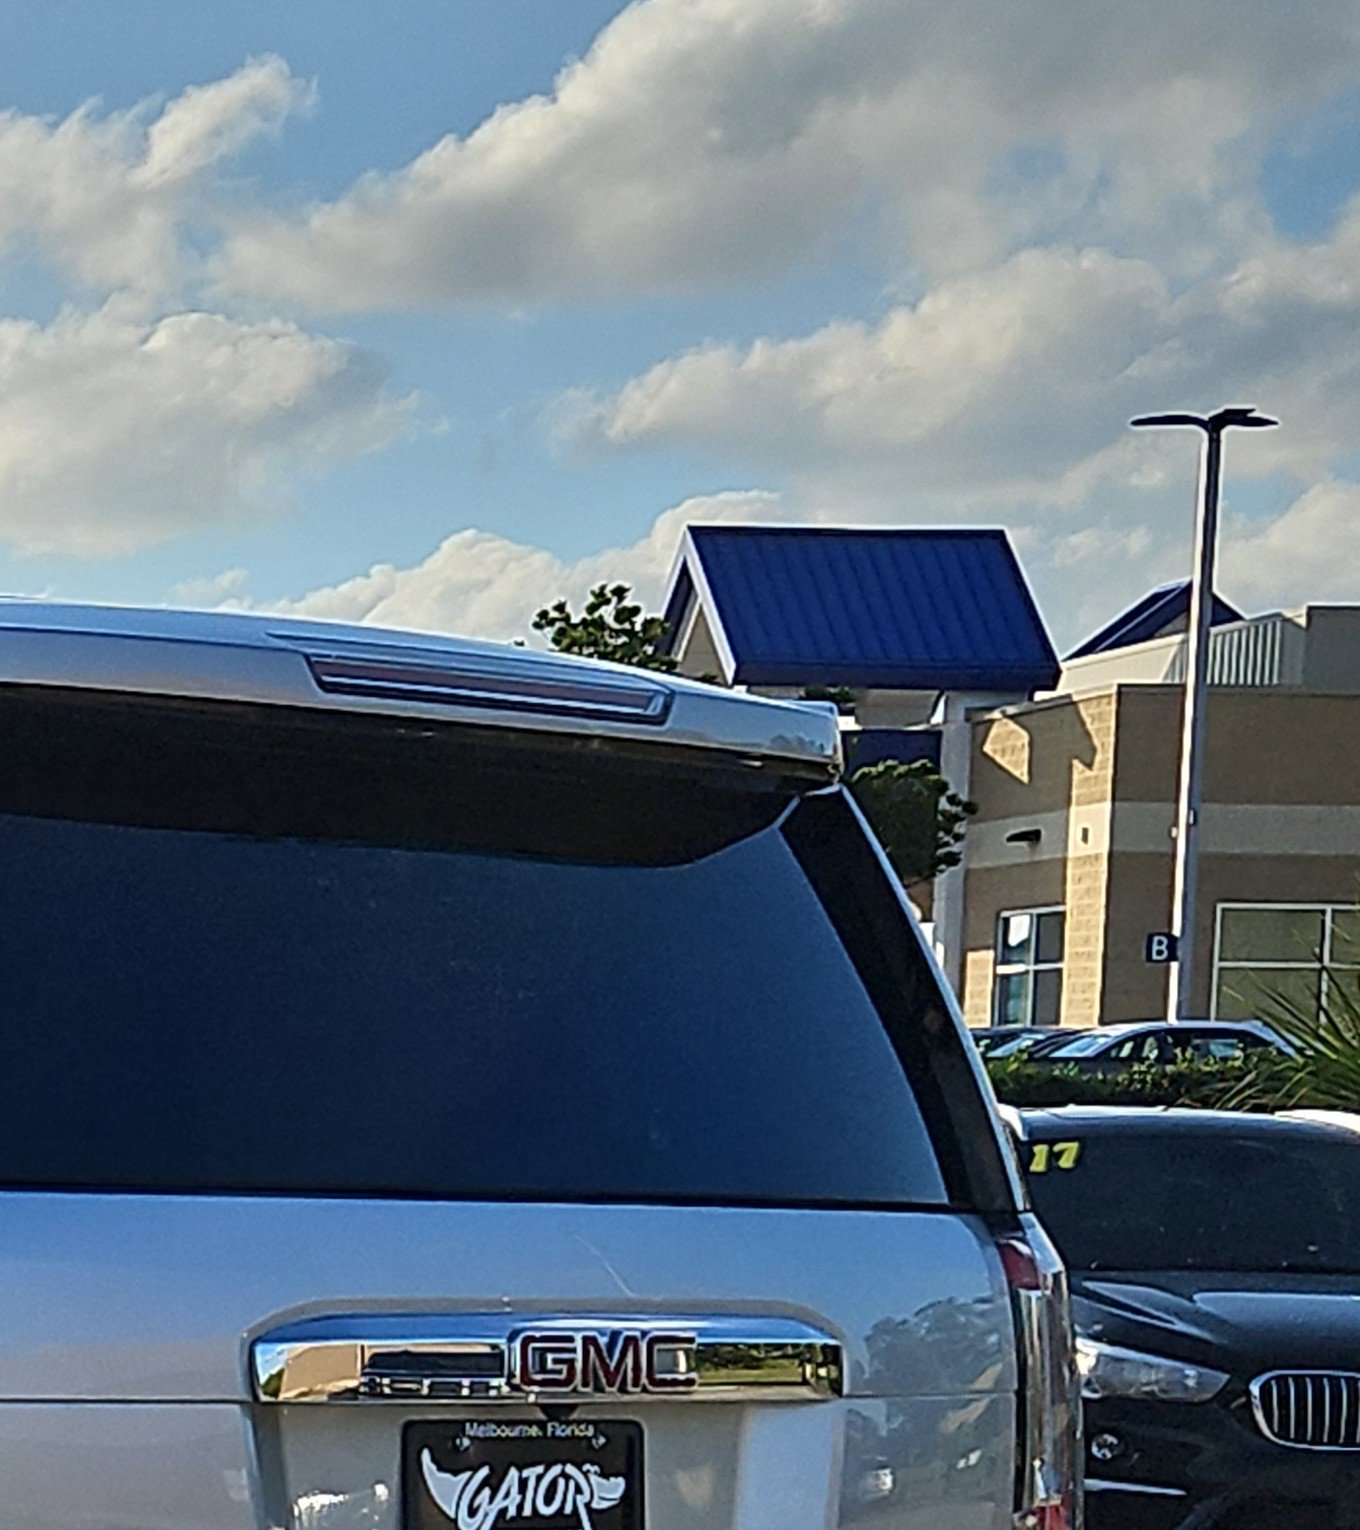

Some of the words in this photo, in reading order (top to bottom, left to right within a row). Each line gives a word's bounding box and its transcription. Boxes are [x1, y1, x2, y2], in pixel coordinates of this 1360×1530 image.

[1151, 936, 1169, 961] B
[1029, 1141, 1080, 1172] 17
[519, 1331, 697, 1393] GMC
